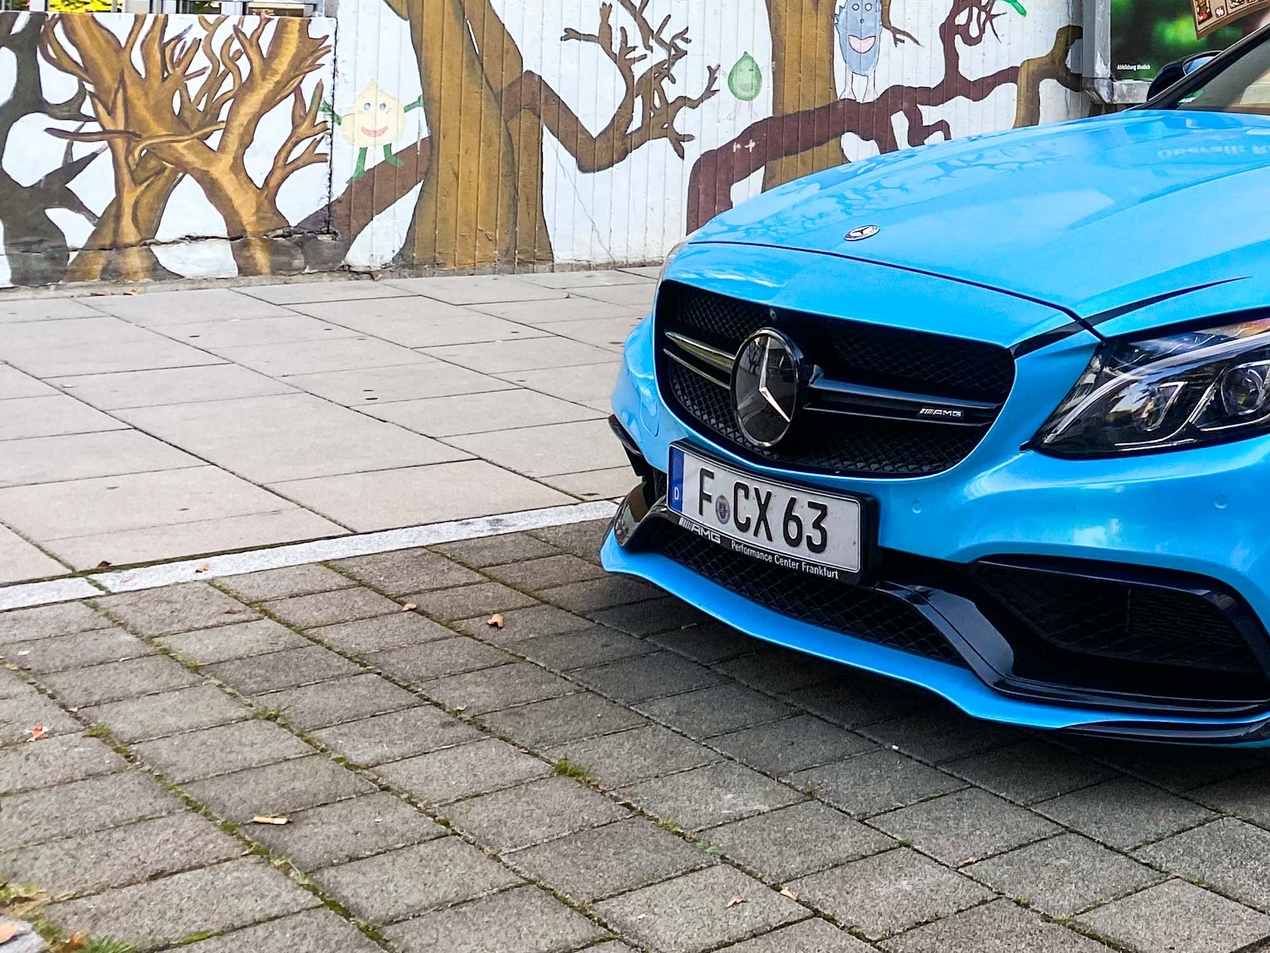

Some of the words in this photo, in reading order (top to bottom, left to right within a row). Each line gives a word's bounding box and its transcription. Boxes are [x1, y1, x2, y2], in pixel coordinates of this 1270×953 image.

[698, 467, 715, 516] F
[733, 480, 773, 542] CX
[782, 496, 828, 554] 63
[690, 523, 721, 545] AMG
[731, 539, 773, 564] Performance
[774, 555, 799, 570] Center
[801, 562, 839, 580] Frankfurt
